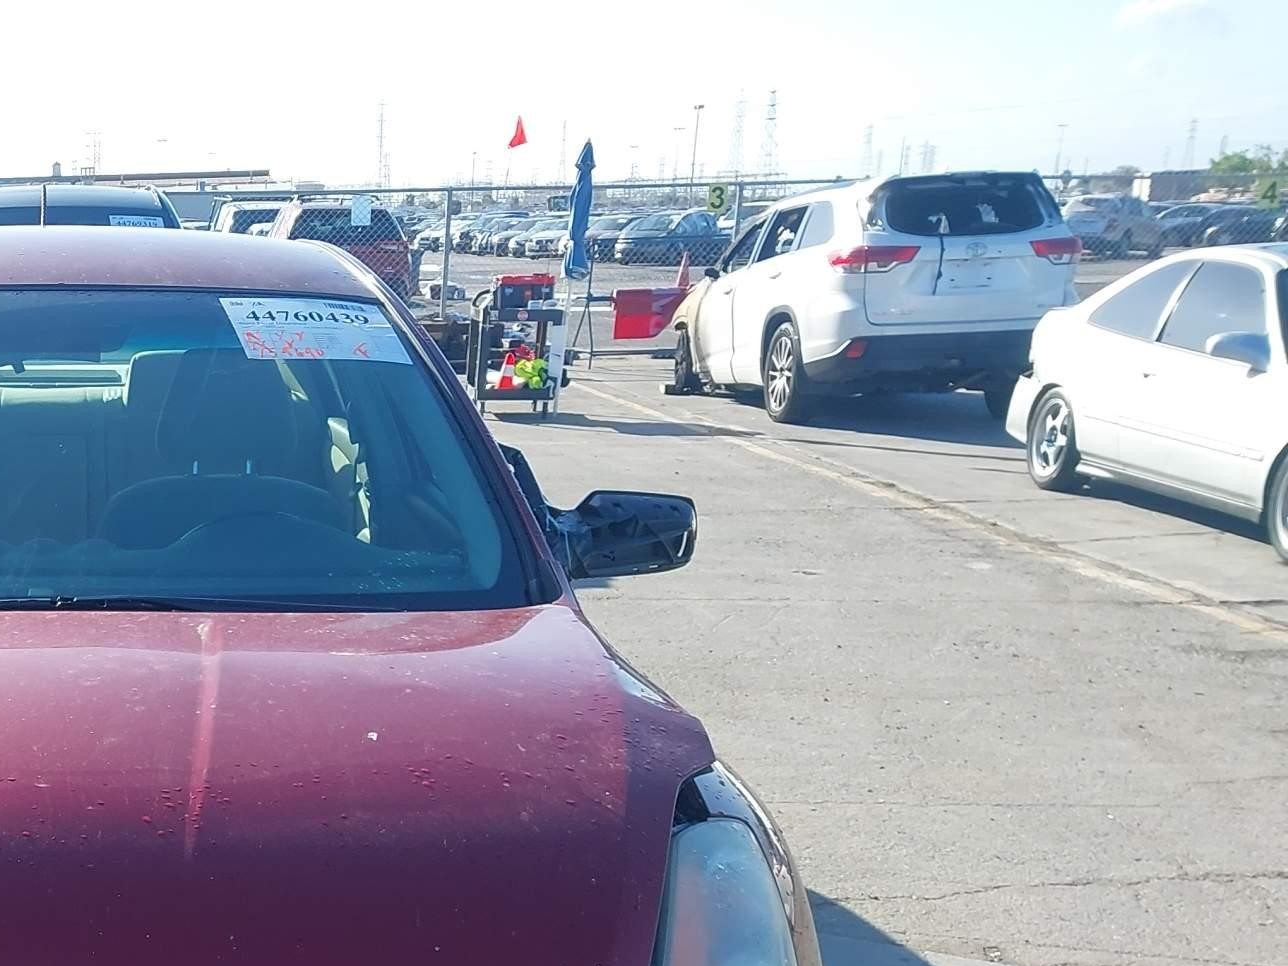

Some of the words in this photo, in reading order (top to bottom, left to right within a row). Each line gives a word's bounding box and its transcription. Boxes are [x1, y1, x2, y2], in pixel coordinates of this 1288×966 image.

[710, 186, 725, 209] 3
[1262, 181, 1278, 204] 4
[245, 309, 370, 325] 44760439
